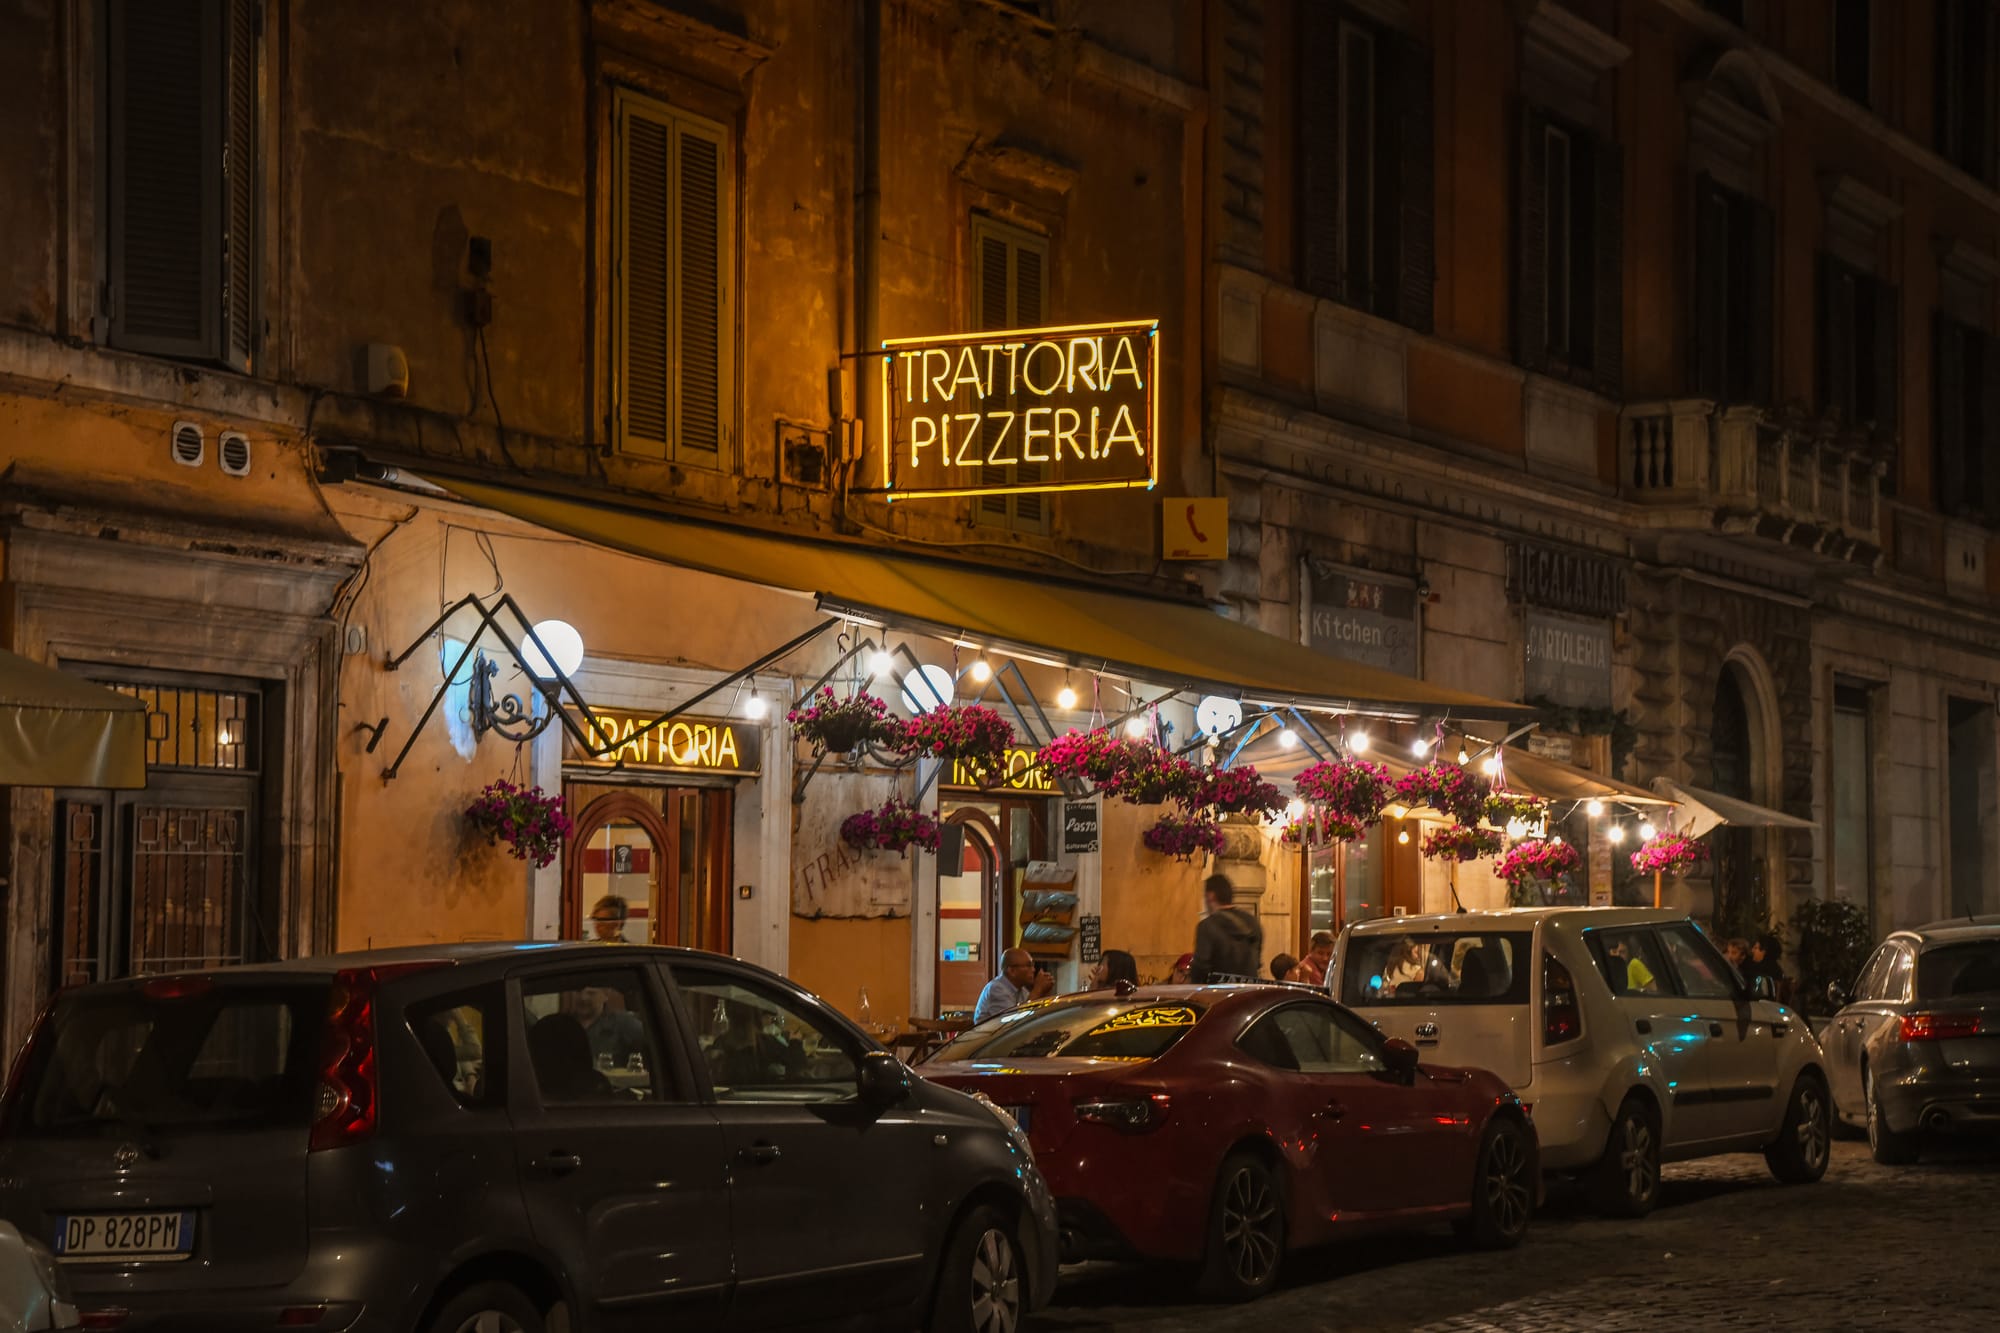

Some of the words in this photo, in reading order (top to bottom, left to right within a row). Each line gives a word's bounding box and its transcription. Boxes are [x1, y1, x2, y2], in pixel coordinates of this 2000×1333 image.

[899, 336, 1144, 404] TRATTORIA
[911, 403, 1145, 468] PIZZERIA
[1312, 609, 1381, 646] Kitchen
[1529, 625, 1606, 670] CARTOLERIA
[584, 715, 739, 768] TRATTORIA
[67, 1217, 96, 1250] DP
[104, 1215, 178, 1249] 828PM
